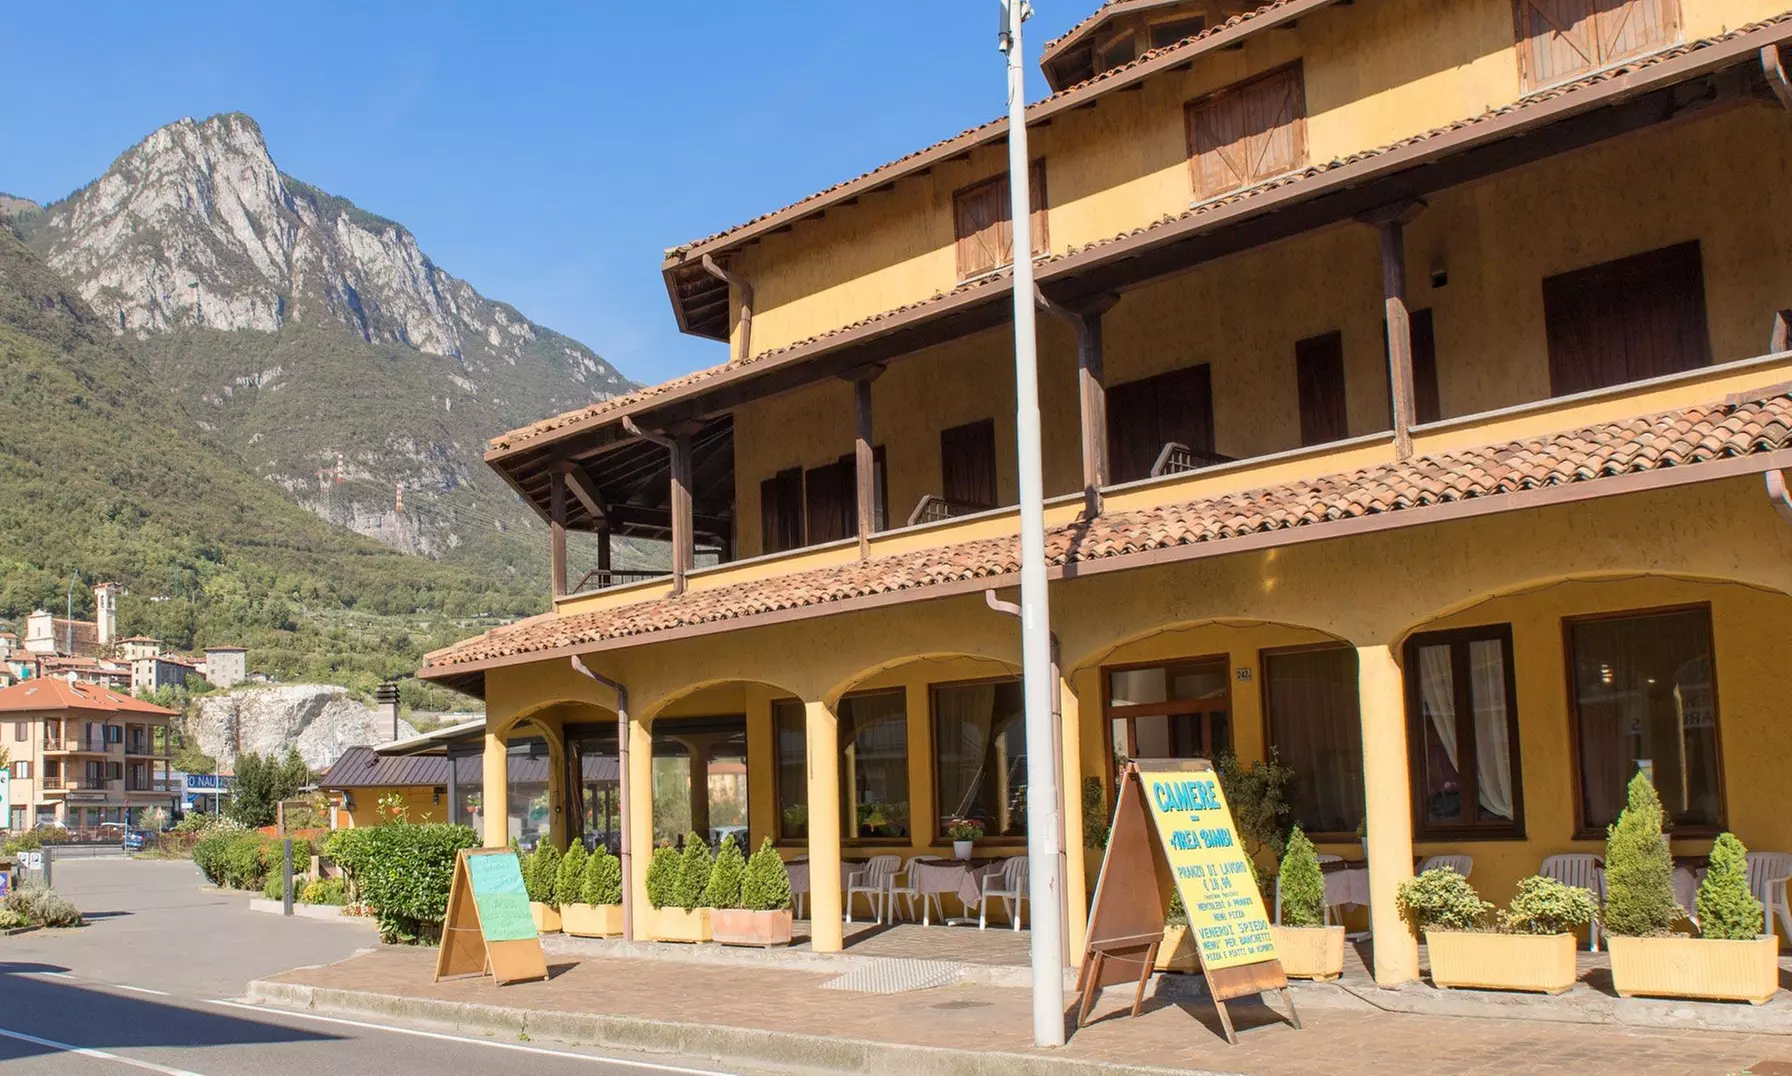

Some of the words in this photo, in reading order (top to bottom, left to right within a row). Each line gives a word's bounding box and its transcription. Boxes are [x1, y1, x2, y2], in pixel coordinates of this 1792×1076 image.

[1153, 781, 1222, 812] CAMERE
[1170, 829, 1202, 850] AREA
[1199, 828, 1234, 848] BIMBI
[1177, 865, 1205, 879] PRANZO
[1206, 864, 1218, 876] DI
[1219, 861, 1247, 875] LAVORO
[1238, 919, 1268, 933] SPIEDO
[1224, 937, 1237, 947] PER
